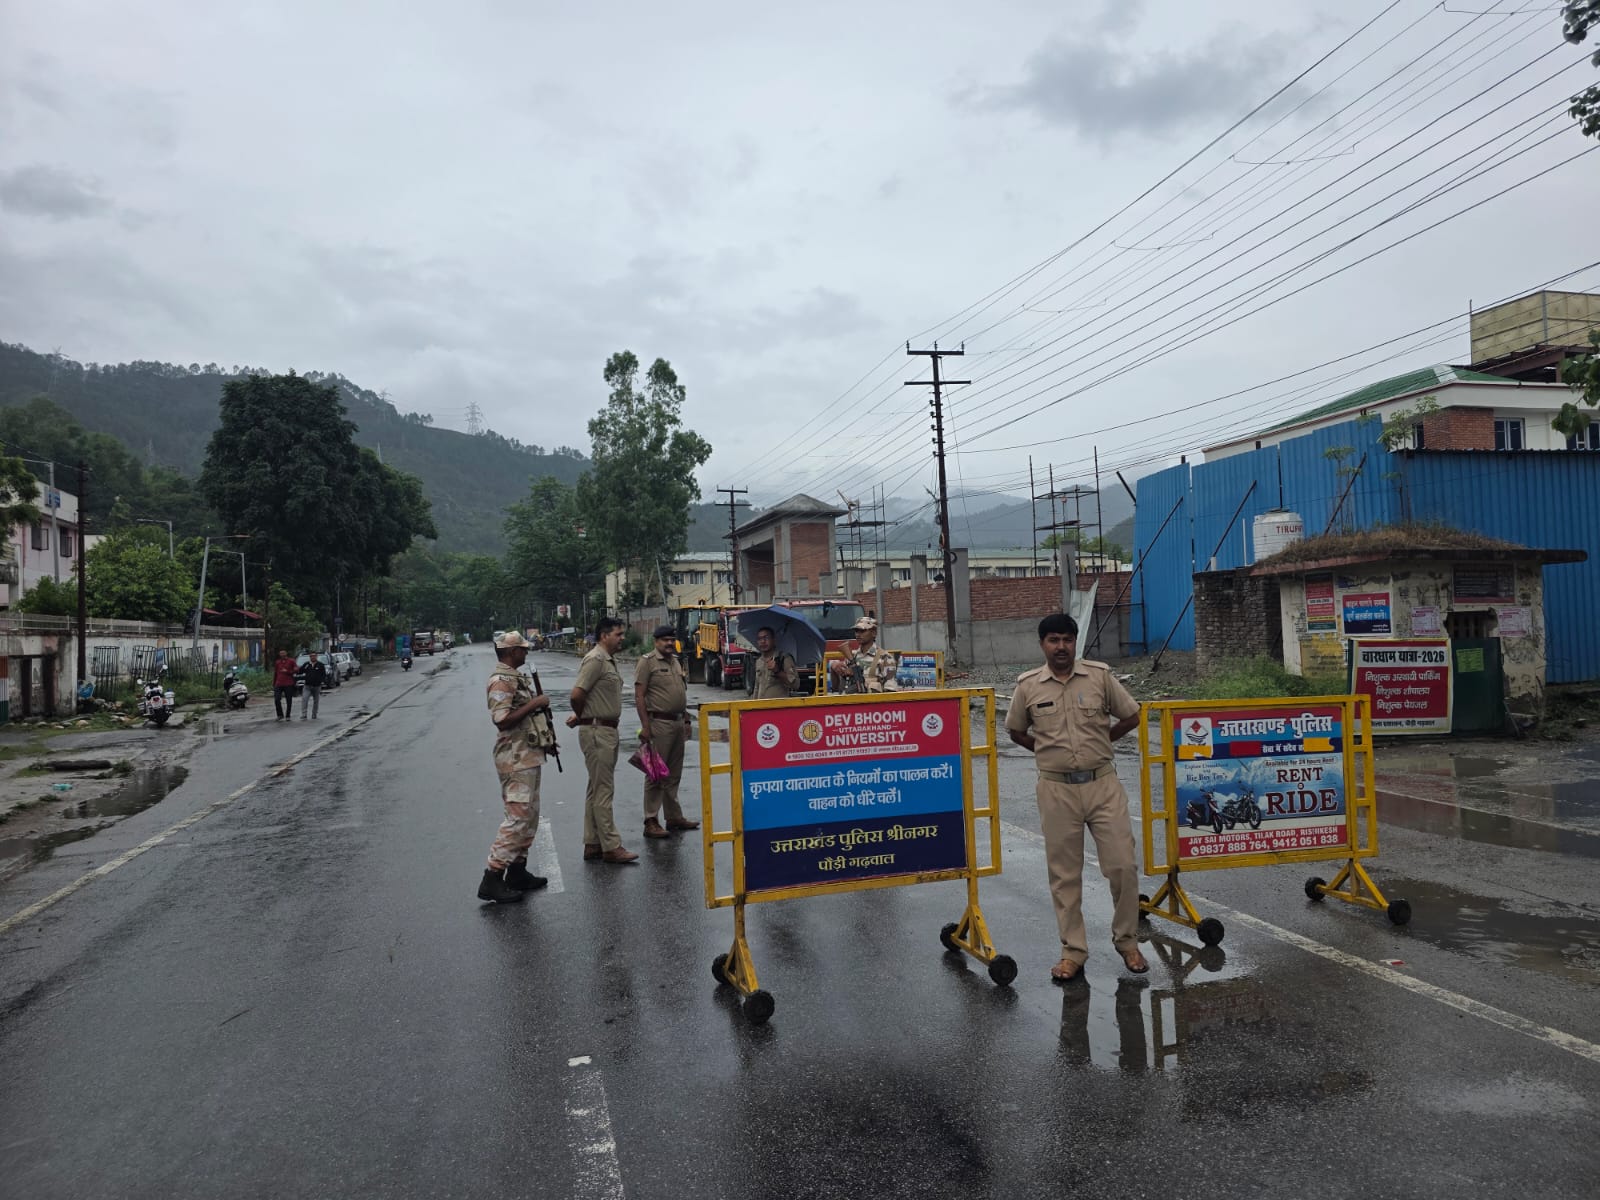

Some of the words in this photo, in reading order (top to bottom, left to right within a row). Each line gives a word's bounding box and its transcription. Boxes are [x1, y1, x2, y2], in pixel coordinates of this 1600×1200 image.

[1362, 650, 1396, 663] चारधाम
[917, 678, 935, 686] RIDE
[825, 713, 852, 728] DEV
[854, 710, 906, 725] BHOOMI
[839, 724, 891, 733] UTTARAKHAND
[1218, 718, 1286, 737] उत्तराखण्ड
[1290, 713, 1333, 739] पुलिस
[826, 730, 906, 747] UNIVERSITY
[749, 779, 783, 800] कृपया
[786, 775, 832, 792] यातायात
[833, 771, 845, 787] के
[847, 767, 881, 786] नियमों
[883, 768, 898, 784] का
[899, 767, 929, 782] पालन
[1277, 767, 1323, 783] RENT
[809, 795, 837, 811] वाहन
[839, 792, 854, 807] को
[857, 789, 876, 806] धीरे
[1265, 790, 1338, 815] RIDE
[770, 831, 836, 854] उत्तराखंड
[839, 827, 883, 852] पुलिस
[887, 824, 938, 841] श्रीनगर
[1188, 837, 1202, 845] JAY
[1204, 836, 1216, 844] SAI
[1219, 834, 1252, 843] MOTORS,
[1254, 832, 1274, 840] TILAK
[1276, 830, 1298, 838] ROAD,
[1300, 826, 1338, 836] RISHIKESH
[1199, 844, 1225, 855] 9837
[1228, 842, 1246, 852] 888
[1249, 840, 1270, 850] 764,
[1272, 837, 1297, 848] 9412
[1300, 836, 1317, 846] 051
[1321, 834, 1338, 844] 838
[818, 856, 846, 872] पौड़ी
[849, 853, 895, 870] गढ़वाल
